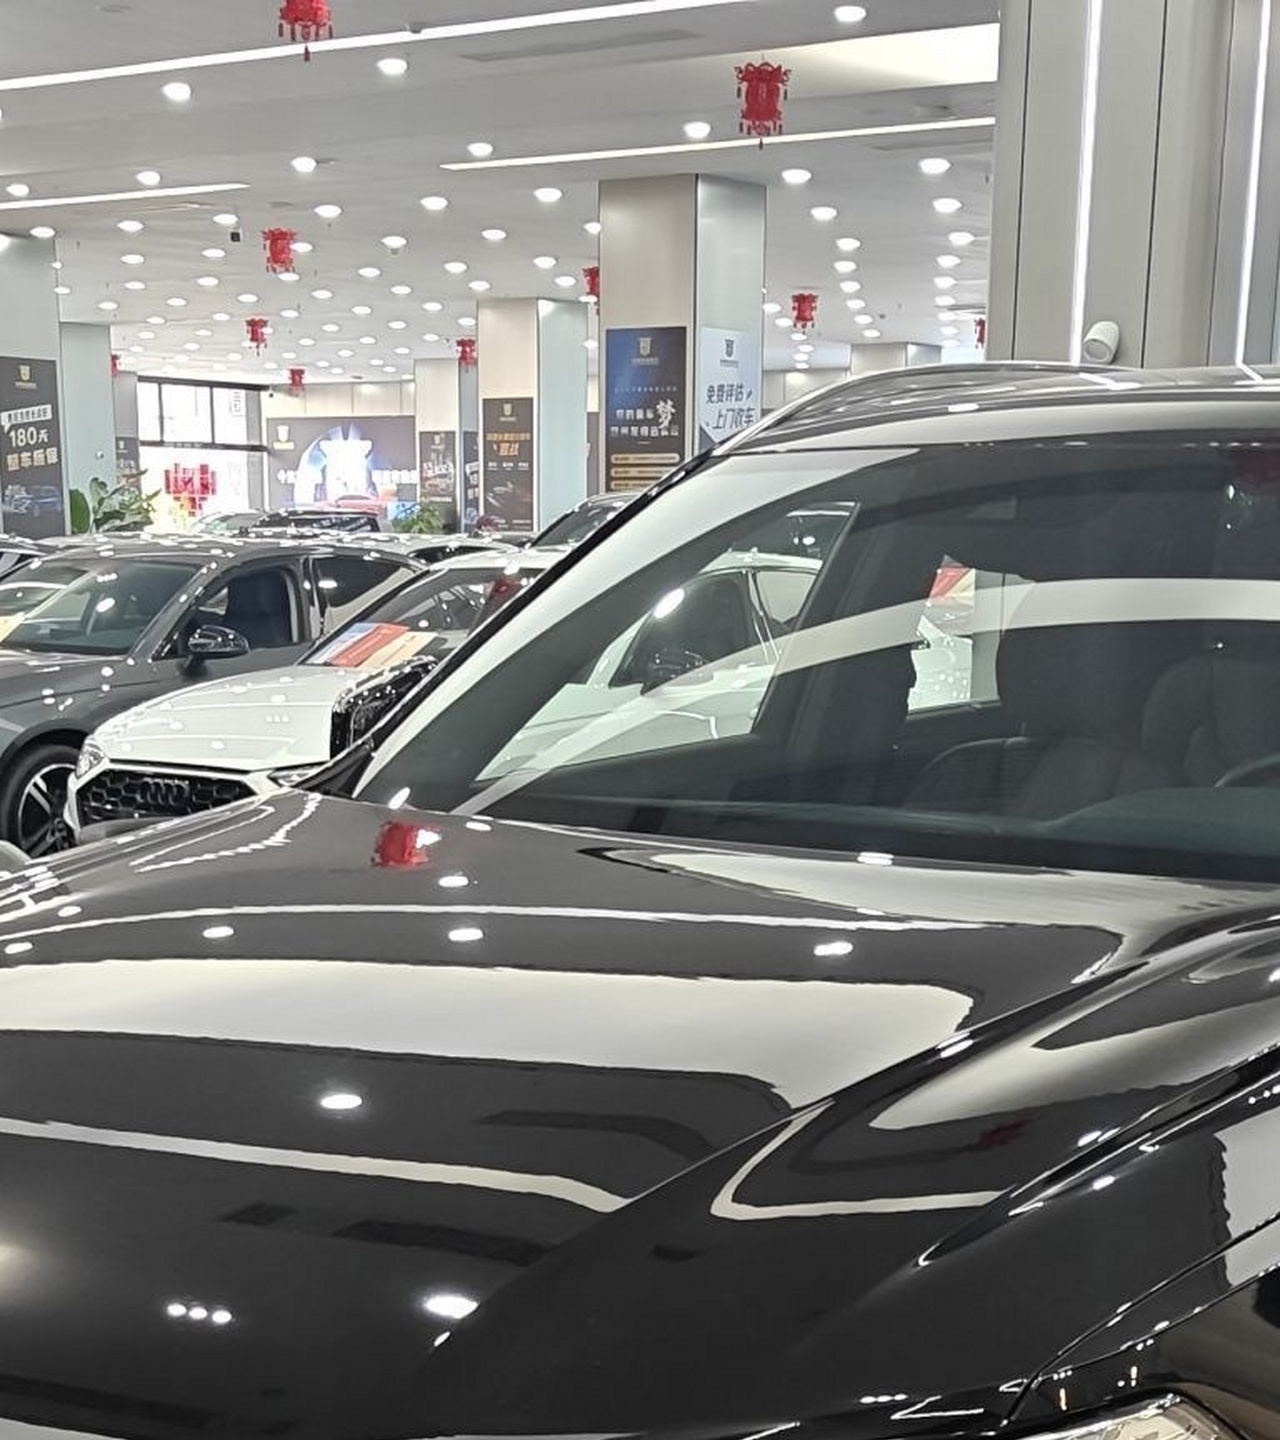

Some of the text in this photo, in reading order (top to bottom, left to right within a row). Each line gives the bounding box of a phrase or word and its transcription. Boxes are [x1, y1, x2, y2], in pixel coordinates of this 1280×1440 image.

[706, 384, 745, 404] 免费评估
[713, 407, 756, 430] 上门收车
[9, 427, 49, 447] 180天
